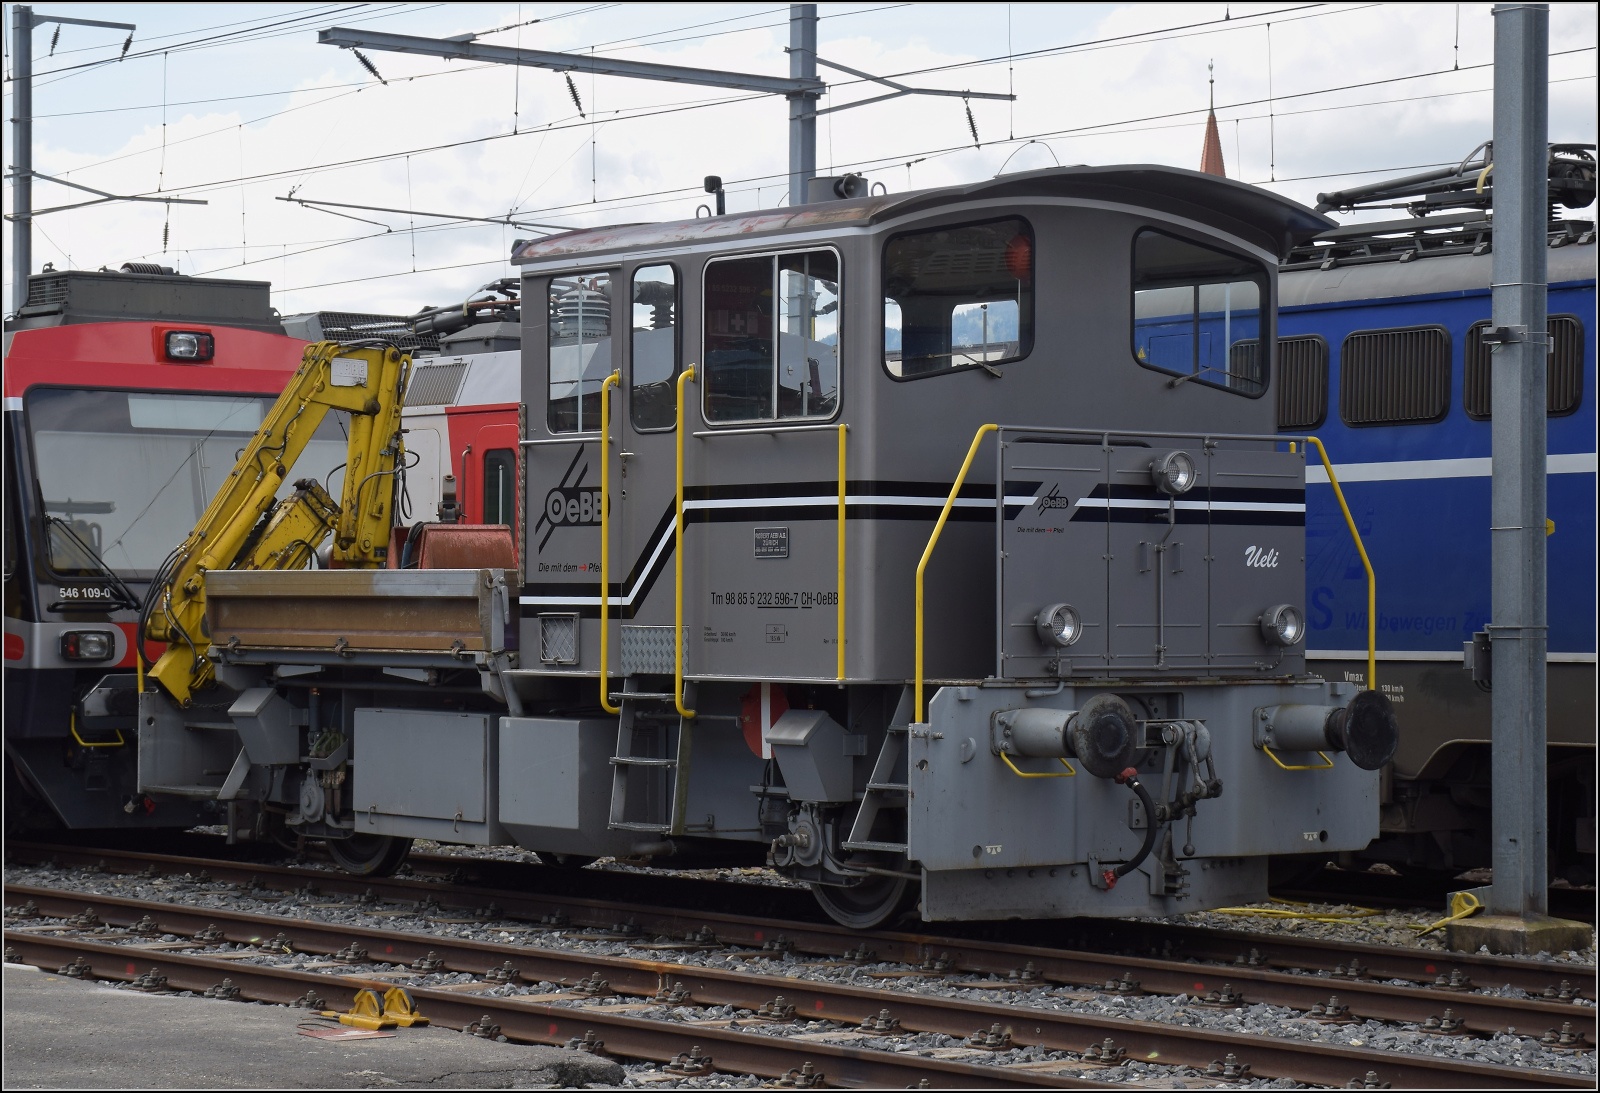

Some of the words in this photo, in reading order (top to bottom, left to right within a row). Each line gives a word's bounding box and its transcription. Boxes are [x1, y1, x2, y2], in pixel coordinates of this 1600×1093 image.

[546, 490, 603, 523] OeBB
[1042, 497, 1067, 508] OeBB
[1245, 545, 1279, 568] Ueli
[538, 562, 549, 572] Die
[551, 562, 562, 572] mit
[563, 562, 578, 572] dem
[588, 562, 603, 572] Pfei
[60, 588, 79, 598] 546
[82, 588, 111, 598] 109-0
[711, 592, 724, 605] Tm
[725, 592, 735, 605] 98
[737, 592, 747, 605] 85
[750, 592, 755, 605] 5
[757, 592, 772, 605] 232
[774, 592, 798, 605] 596-7
[801, 592, 839, 605] CH-OeBB
[1345, 612, 1369, 630] Wi
[1378, 611, 1456, 635] bewegen
[1344, 671, 1364, 682] Vmax
